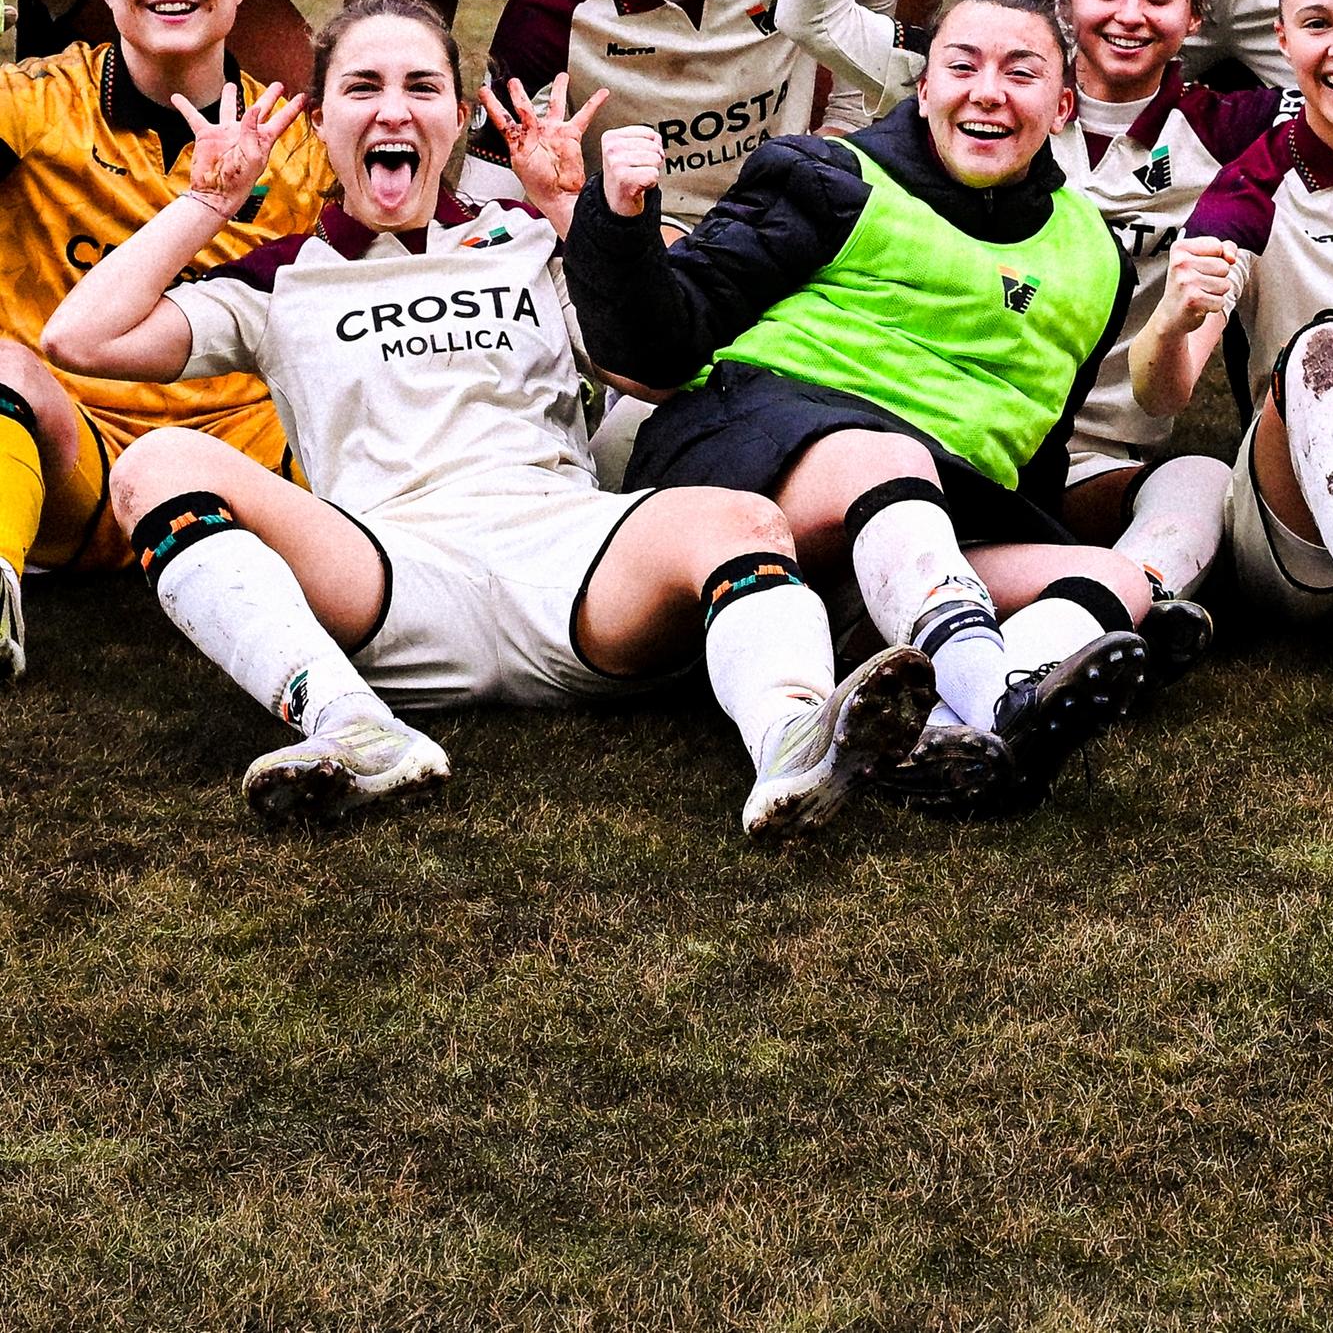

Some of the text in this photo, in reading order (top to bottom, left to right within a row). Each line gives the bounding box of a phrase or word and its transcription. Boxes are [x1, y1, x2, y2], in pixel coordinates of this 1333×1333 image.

[628, 79, 788, 149] ROSTA
[336, 286, 541, 342] CROSTA
[381, 330, 513, 362] MOLLICA
